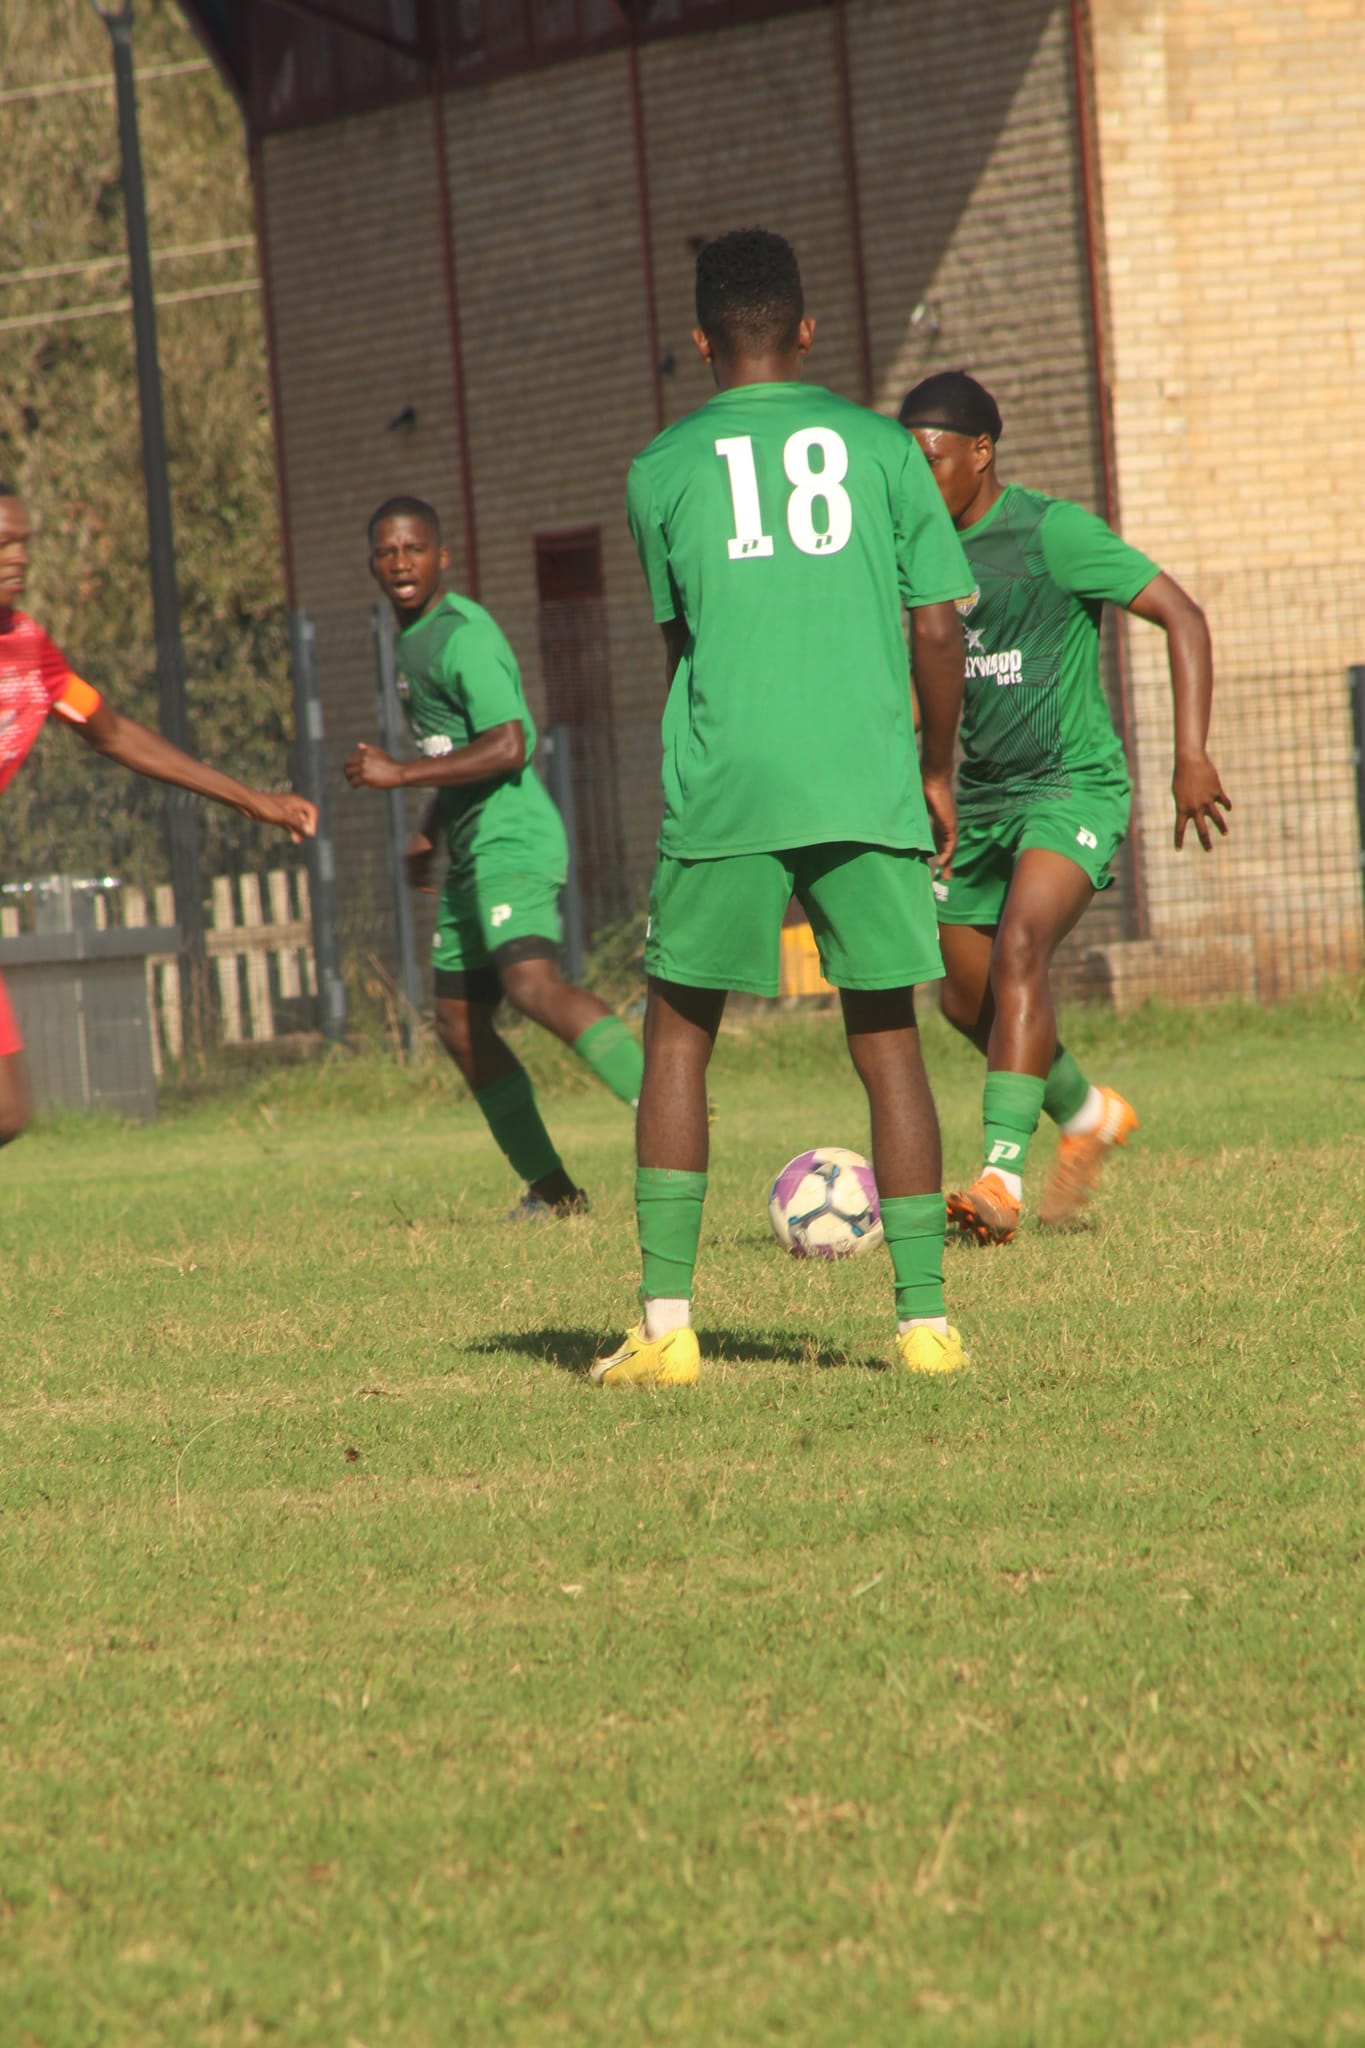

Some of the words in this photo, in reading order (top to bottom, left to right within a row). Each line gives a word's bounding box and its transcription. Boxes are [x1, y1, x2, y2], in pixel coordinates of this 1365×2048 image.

[714, 426, 852, 560] 18
[996, 671, 1023, 685] bets
[988, 1140, 1021, 1164] P
